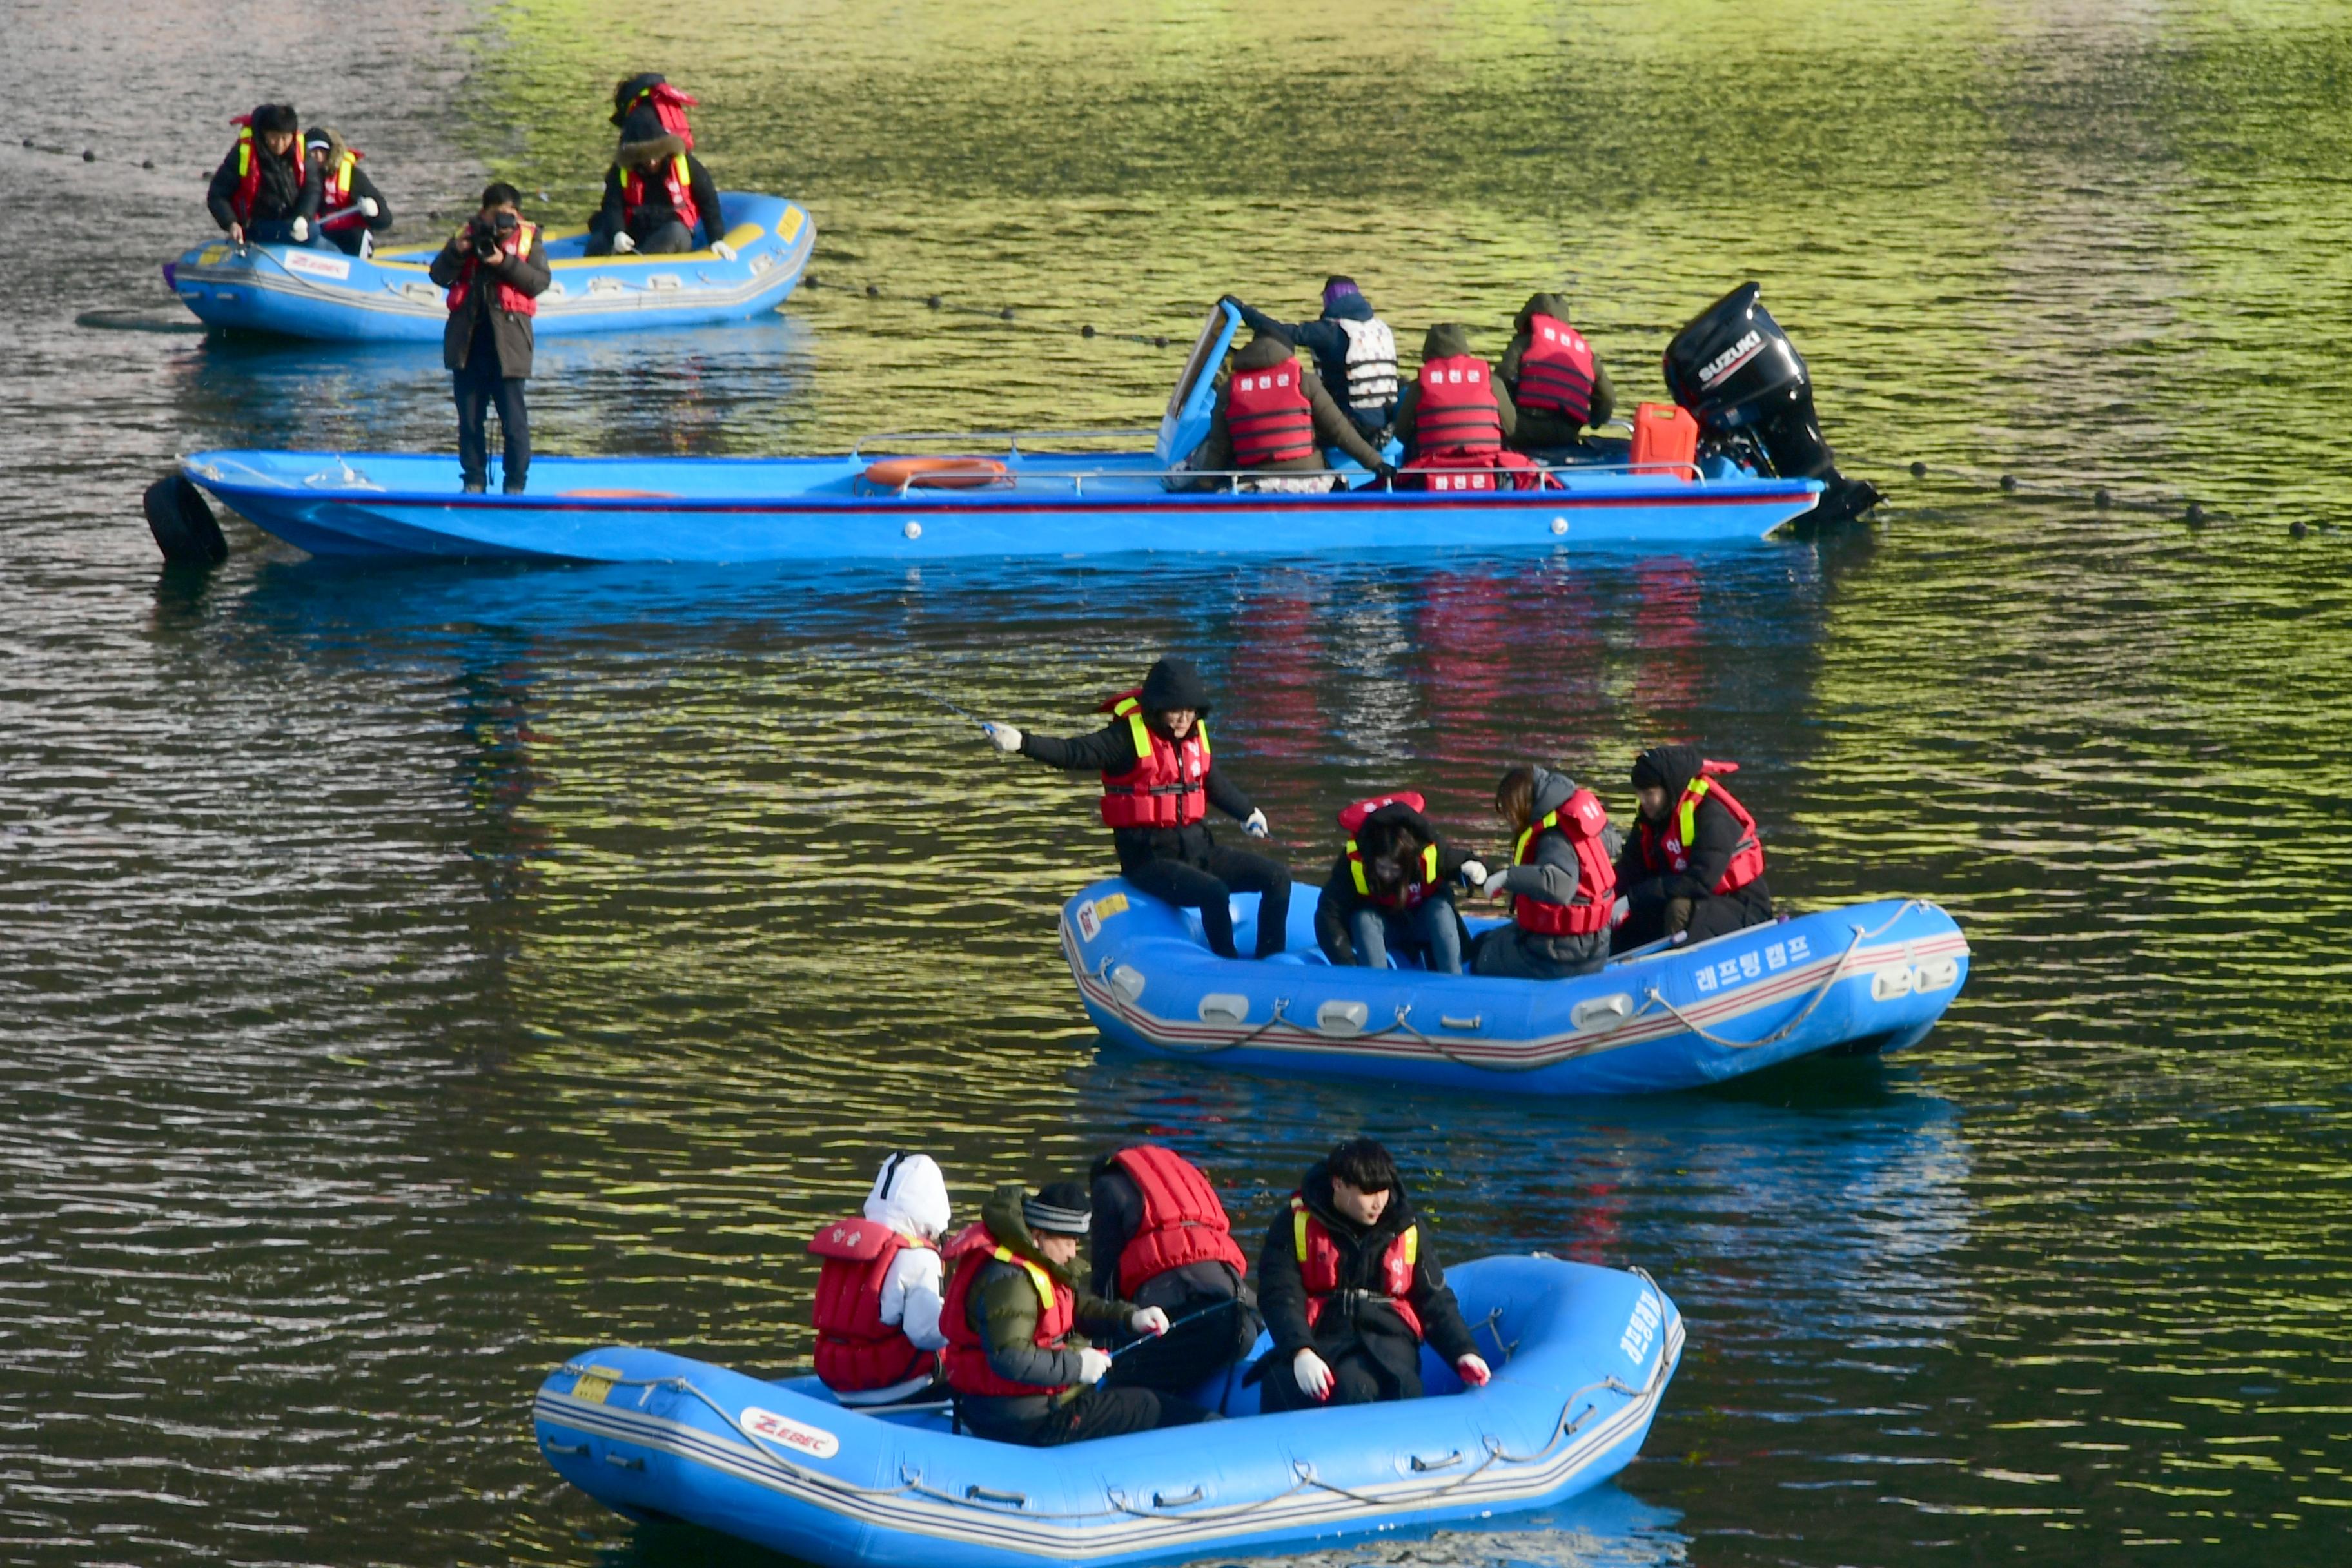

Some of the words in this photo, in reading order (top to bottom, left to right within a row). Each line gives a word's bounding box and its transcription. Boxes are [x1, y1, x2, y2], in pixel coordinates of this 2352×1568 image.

[1698, 329, 1761, 382] SUZUKI
[1695, 950, 1761, 992] 래프팅
[1765, 935, 1810, 971] 캠프
[754, 1415, 828, 1451] ZEBEC
